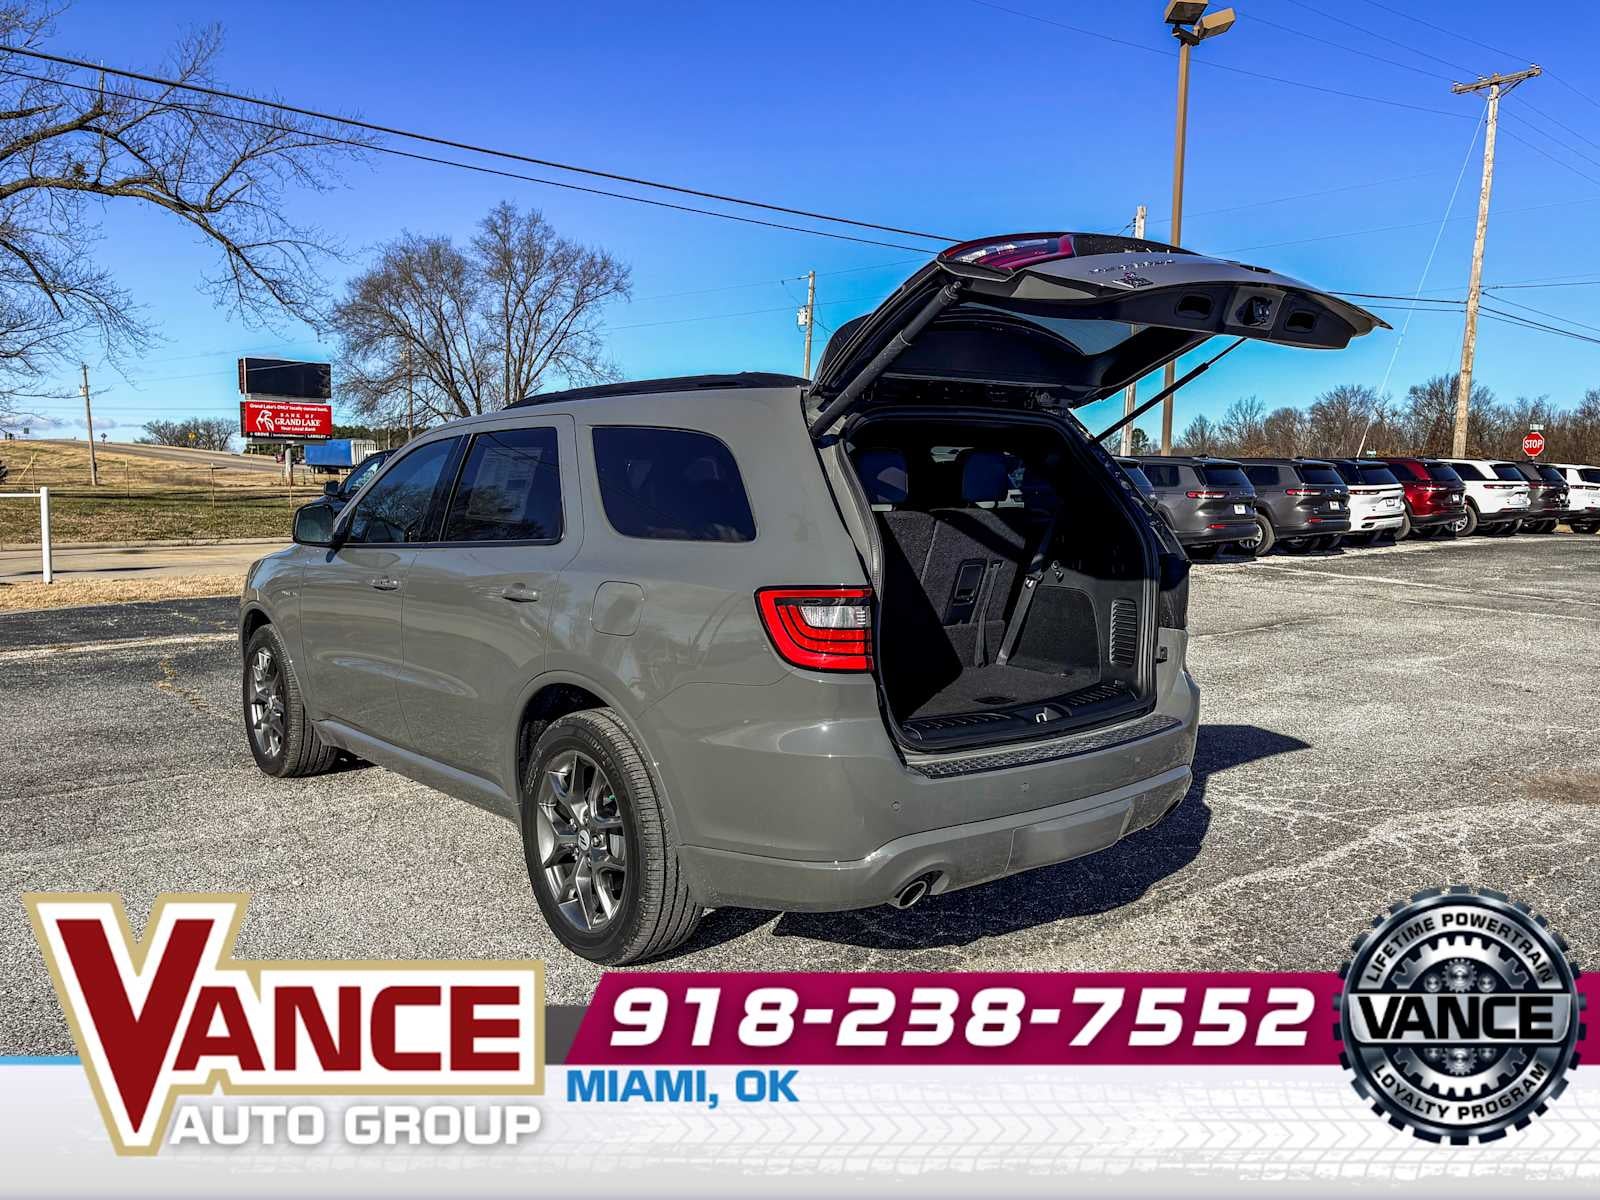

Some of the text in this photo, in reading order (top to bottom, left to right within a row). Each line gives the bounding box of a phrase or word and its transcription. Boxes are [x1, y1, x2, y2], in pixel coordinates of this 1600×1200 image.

[274, 418, 321, 427] GRAND LAKE
[1524, 439, 1543, 449] STOP
